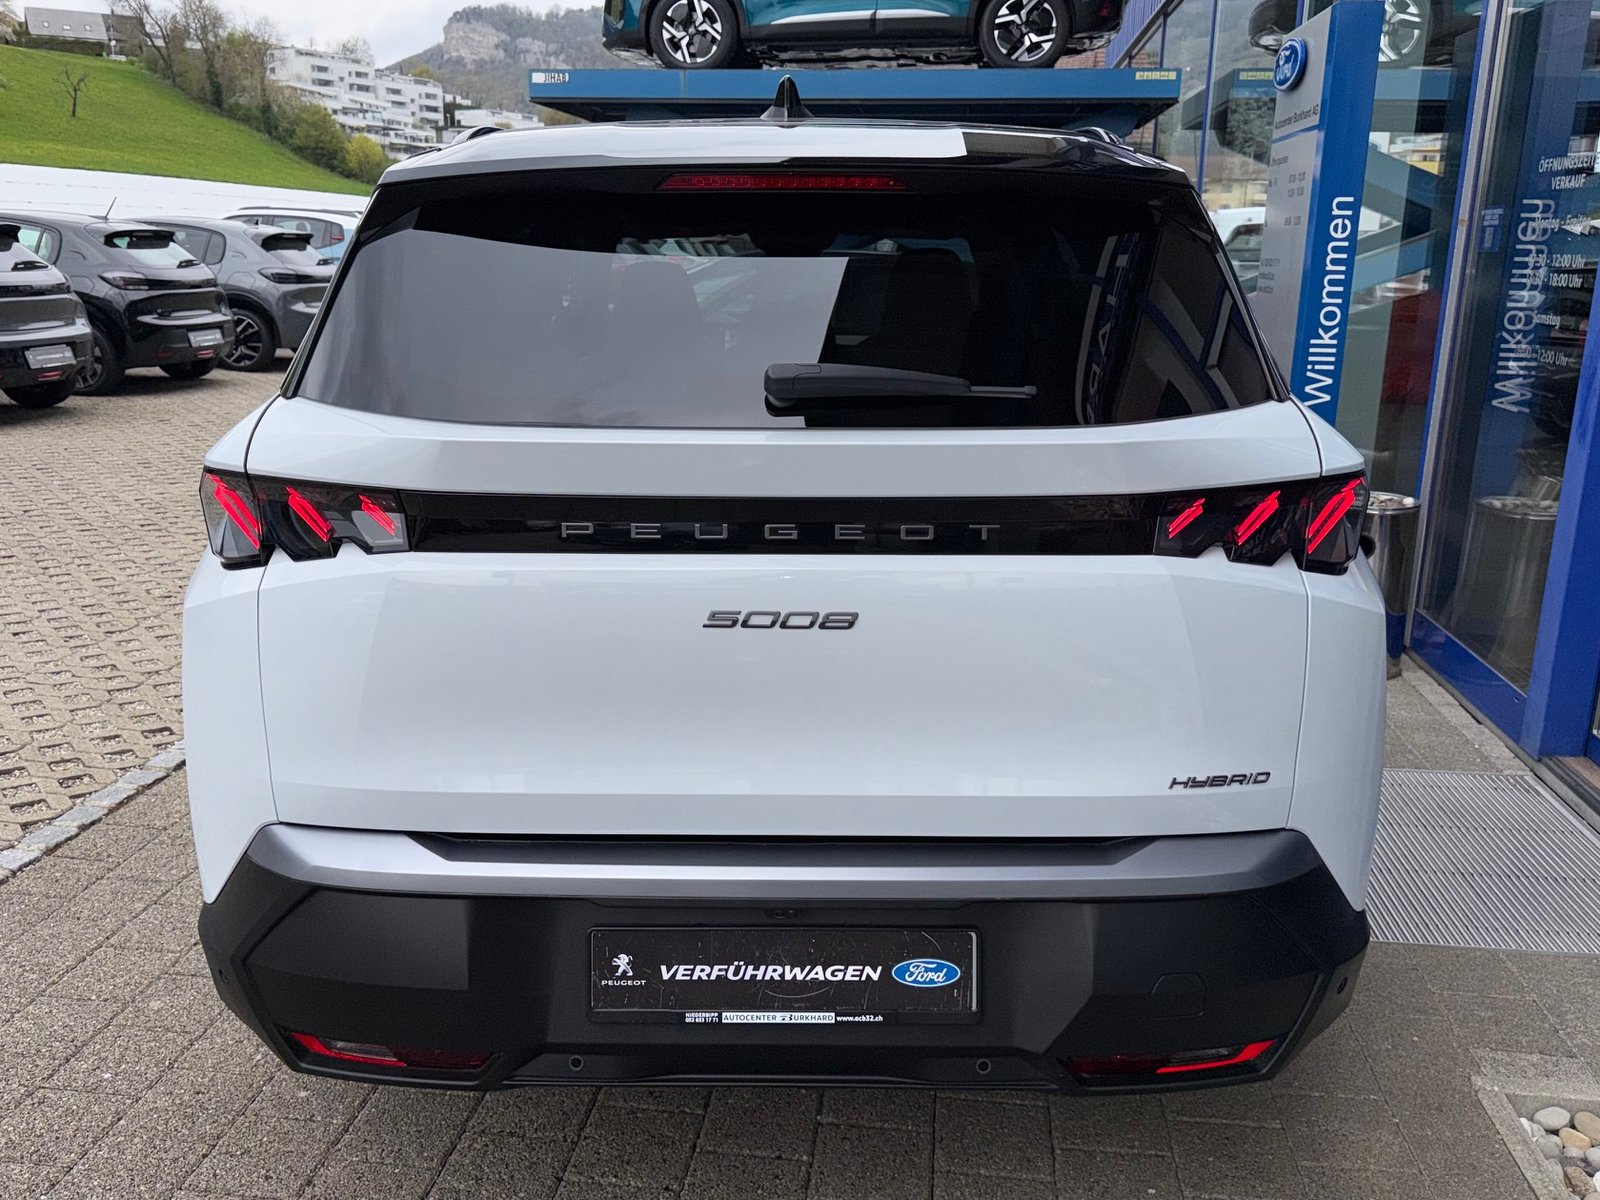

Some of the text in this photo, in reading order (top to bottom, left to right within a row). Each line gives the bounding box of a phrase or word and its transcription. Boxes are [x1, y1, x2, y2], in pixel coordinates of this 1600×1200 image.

[1552, 174, 1587, 190] VERKAUF
[1551, 254, 1571, 268] 12:00
[1572, 254, 1586, 268] Uhr
[1549, 273, 1569, 287] 18:00
[1569, 274, 1584, 289] Uhr
[1302, 195, 1355, 406] Willkommen
[1537, 349, 1555, 363] 12:00
[1556, 352, 1569, 366] Uhr
[561, 522, 1001, 541] PEUGEOT
[702, 609, 860, 631] 5008
[1168, 771, 1271, 790] HYBRID
[660, 961, 883, 982] VERFÜHRWAGEN
[601, 979, 647, 987] PEUGEOT
[723, 1014, 778, 1022] AUTOCENTER
